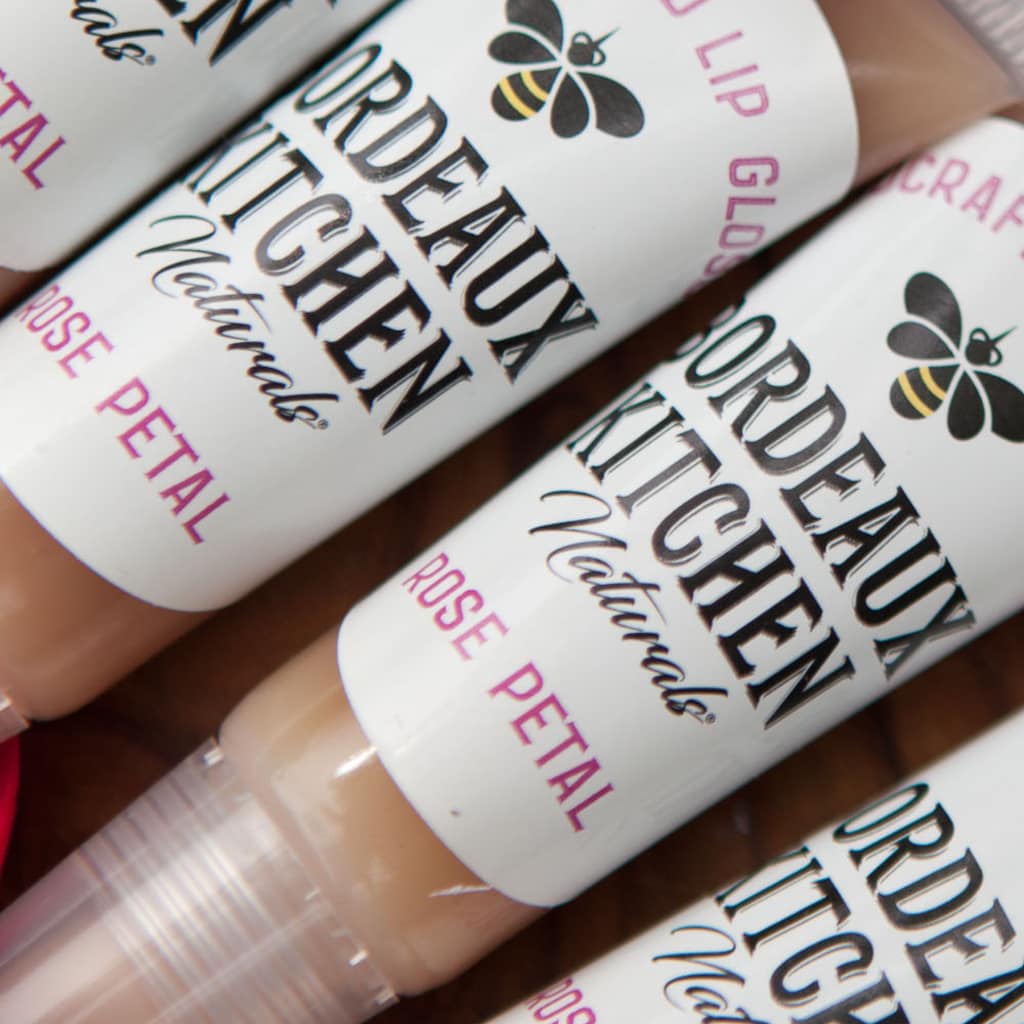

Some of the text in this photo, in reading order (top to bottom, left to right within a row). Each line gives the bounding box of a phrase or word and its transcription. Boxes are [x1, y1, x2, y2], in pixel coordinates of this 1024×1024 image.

[695, 30, 769, 118] LIP
[17, 283, 231, 545] ROSE PETAL
[565, 382, 857, 730] KITCHEN
[401, 552, 615, 833] ROSE PETAL
